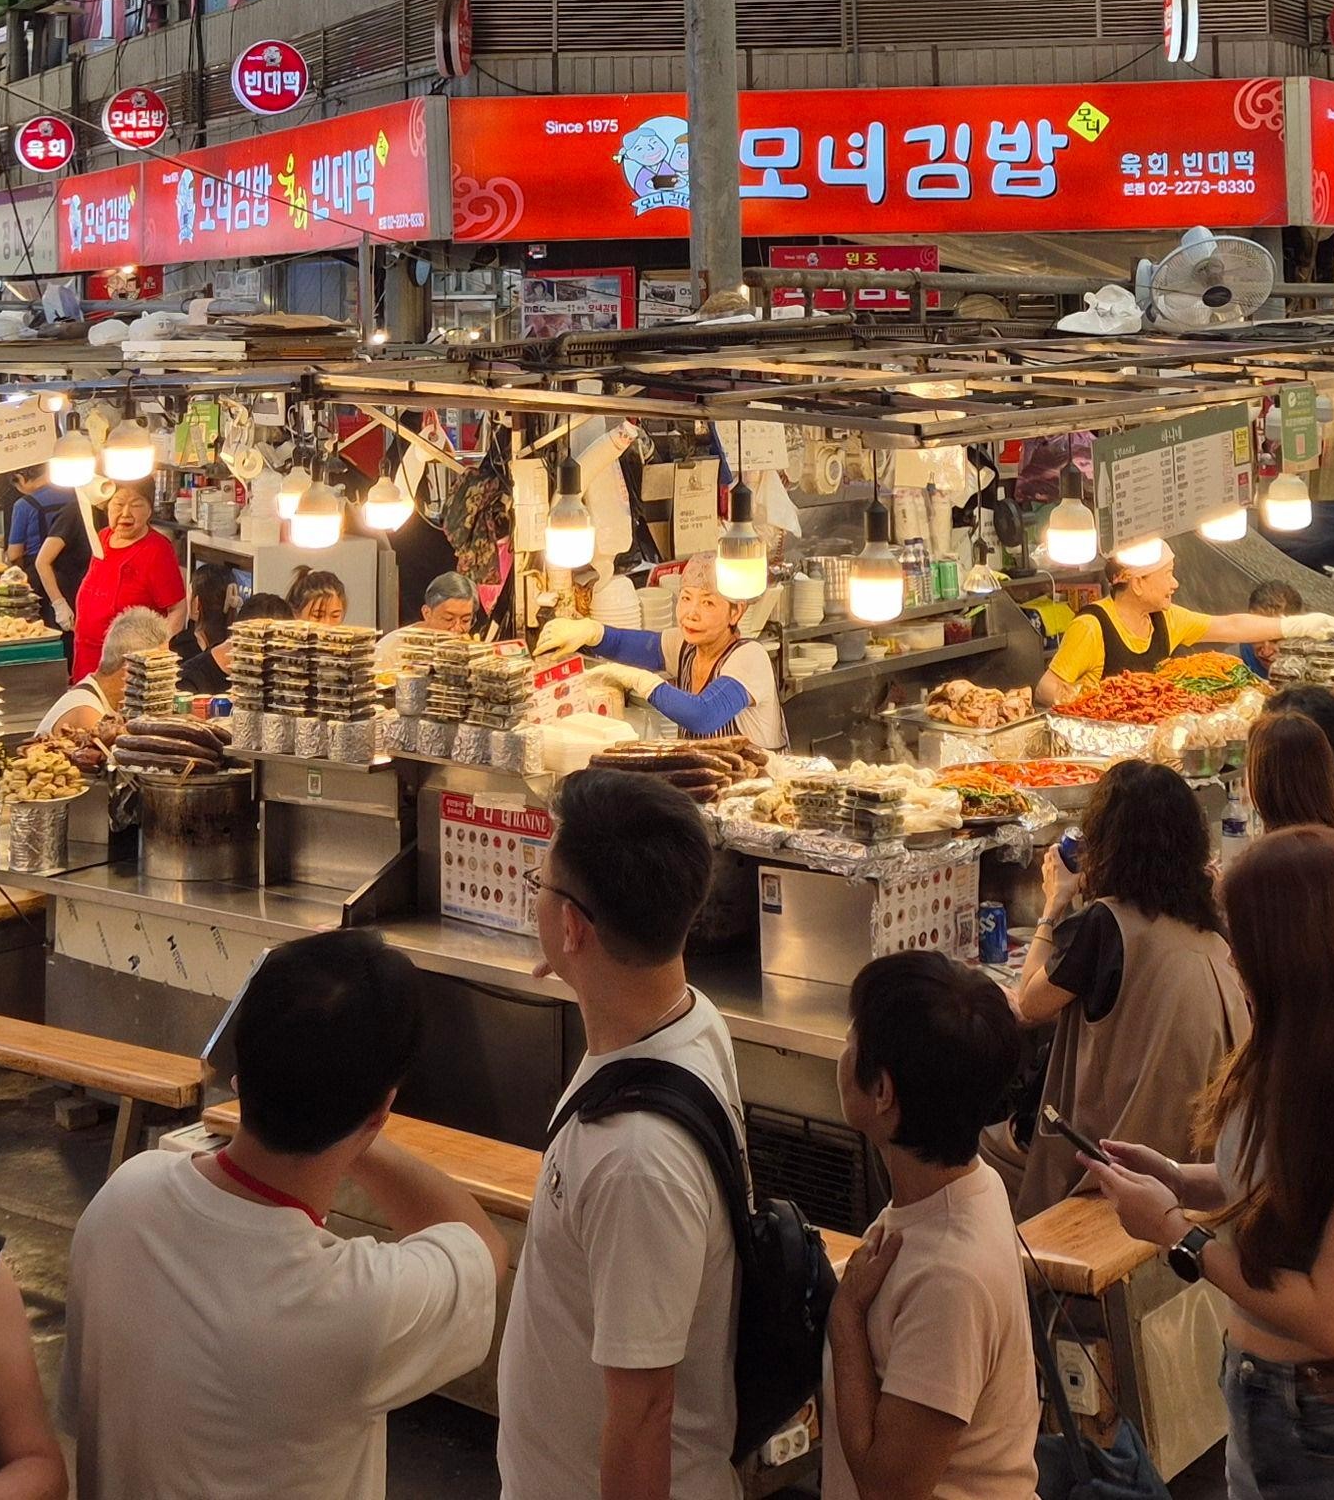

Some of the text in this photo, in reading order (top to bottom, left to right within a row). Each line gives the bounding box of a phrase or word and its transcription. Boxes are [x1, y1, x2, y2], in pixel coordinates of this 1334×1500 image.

[244, 70, 301, 97] 빈대떡
[110, 110, 165, 129] 모녀김밥
[545, 118, 618, 134] Since 1975
[26, 138, 66, 160] 육회
[739, 119, 1070, 205] 모녀김밥
[1120, 151, 1255, 178] 육회.빈대떡
[199, 162, 272, 233] 모녀김밥
[311, 144, 375, 222] 빈대떡
[1123, 180, 1255, 196] 본점 02-2273-8330
[85, 193, 131, 245] 모녀김밥
[845, 251, 878, 266] 원조
